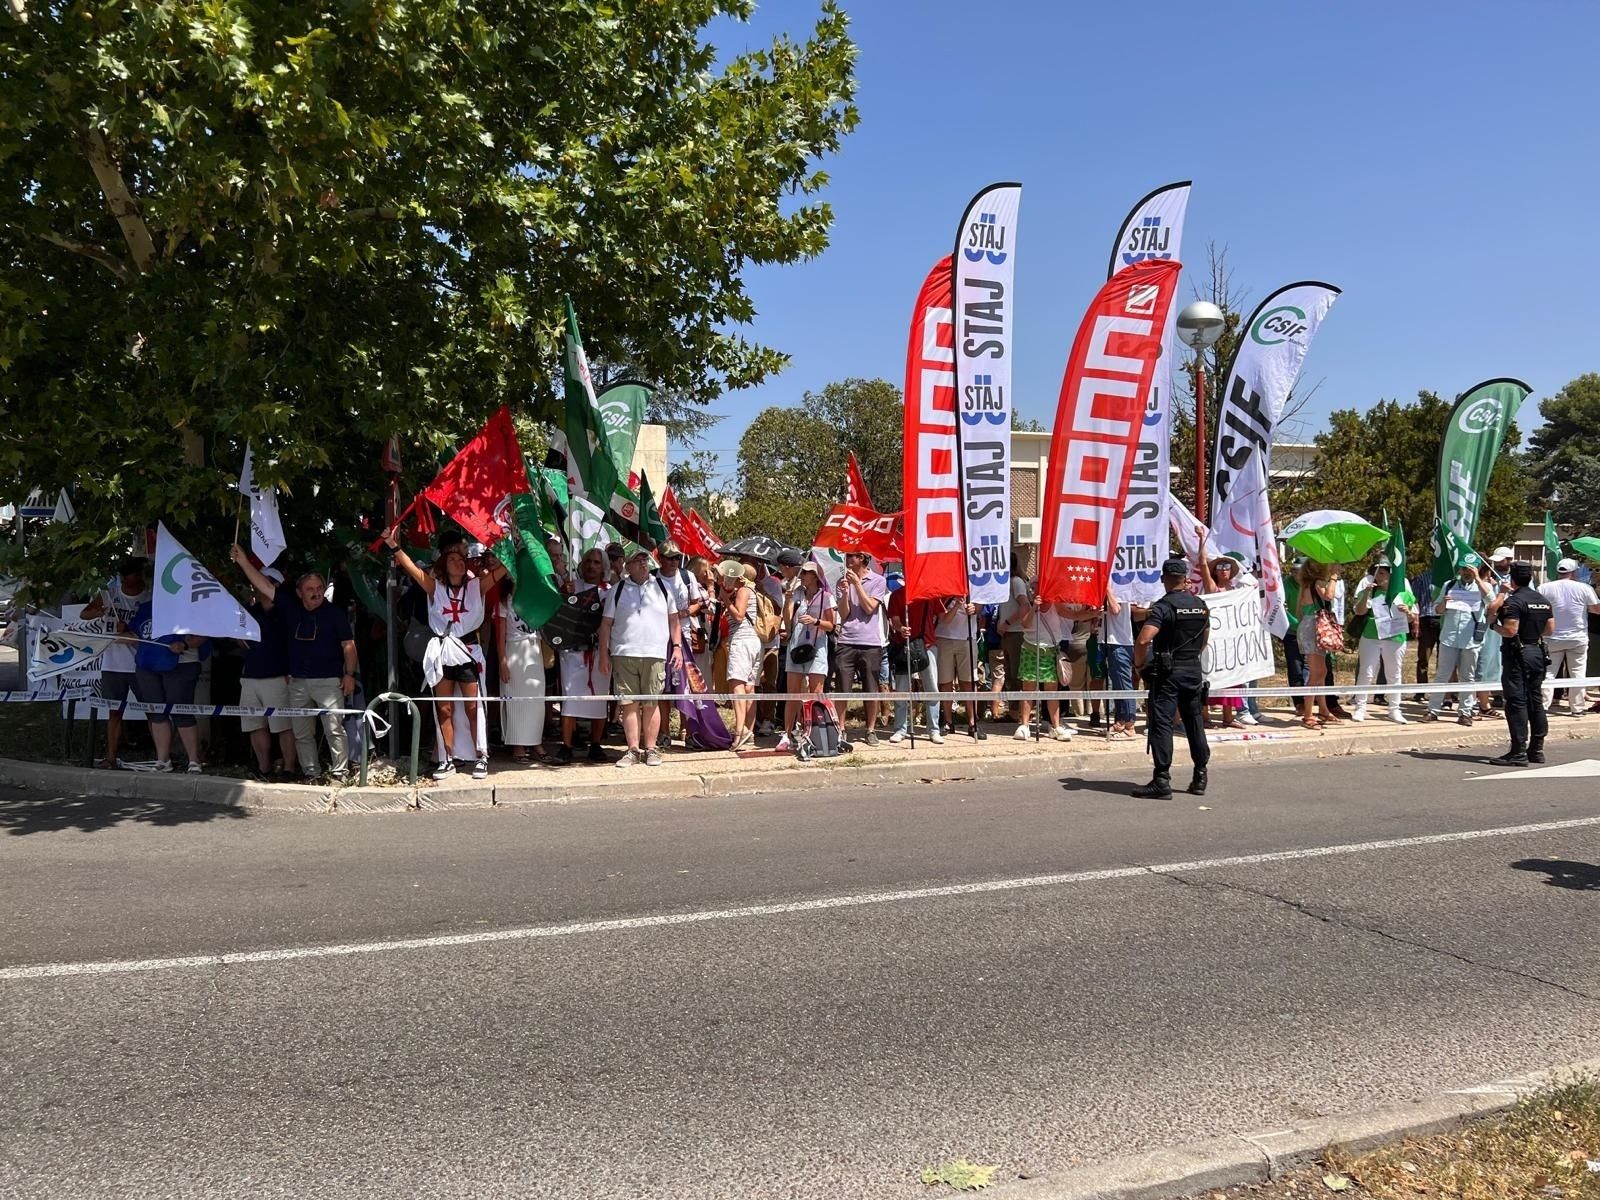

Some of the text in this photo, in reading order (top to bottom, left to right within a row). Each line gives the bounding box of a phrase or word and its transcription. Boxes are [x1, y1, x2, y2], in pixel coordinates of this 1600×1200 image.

[969, 223, 1005, 250] STAJ
[1129, 227, 1170, 251] STAJ
[963, 278, 1004, 359] STAJ
[1264, 316, 1307, 337] CSIF
[965, 385, 1003, 411] STAJ
[601, 411, 632, 428] CSIF
[1053, 315, 1154, 562] CCOO
[963, 441, 1005, 520] STAJ
[1447, 460, 1476, 545] SIF
[971, 547, 1006, 572] STAJ
[1115, 545, 1157, 570] STAJ
[1209, 600, 1262, 630] STICIA
[1200, 630, 1268, 675] OLUCION
